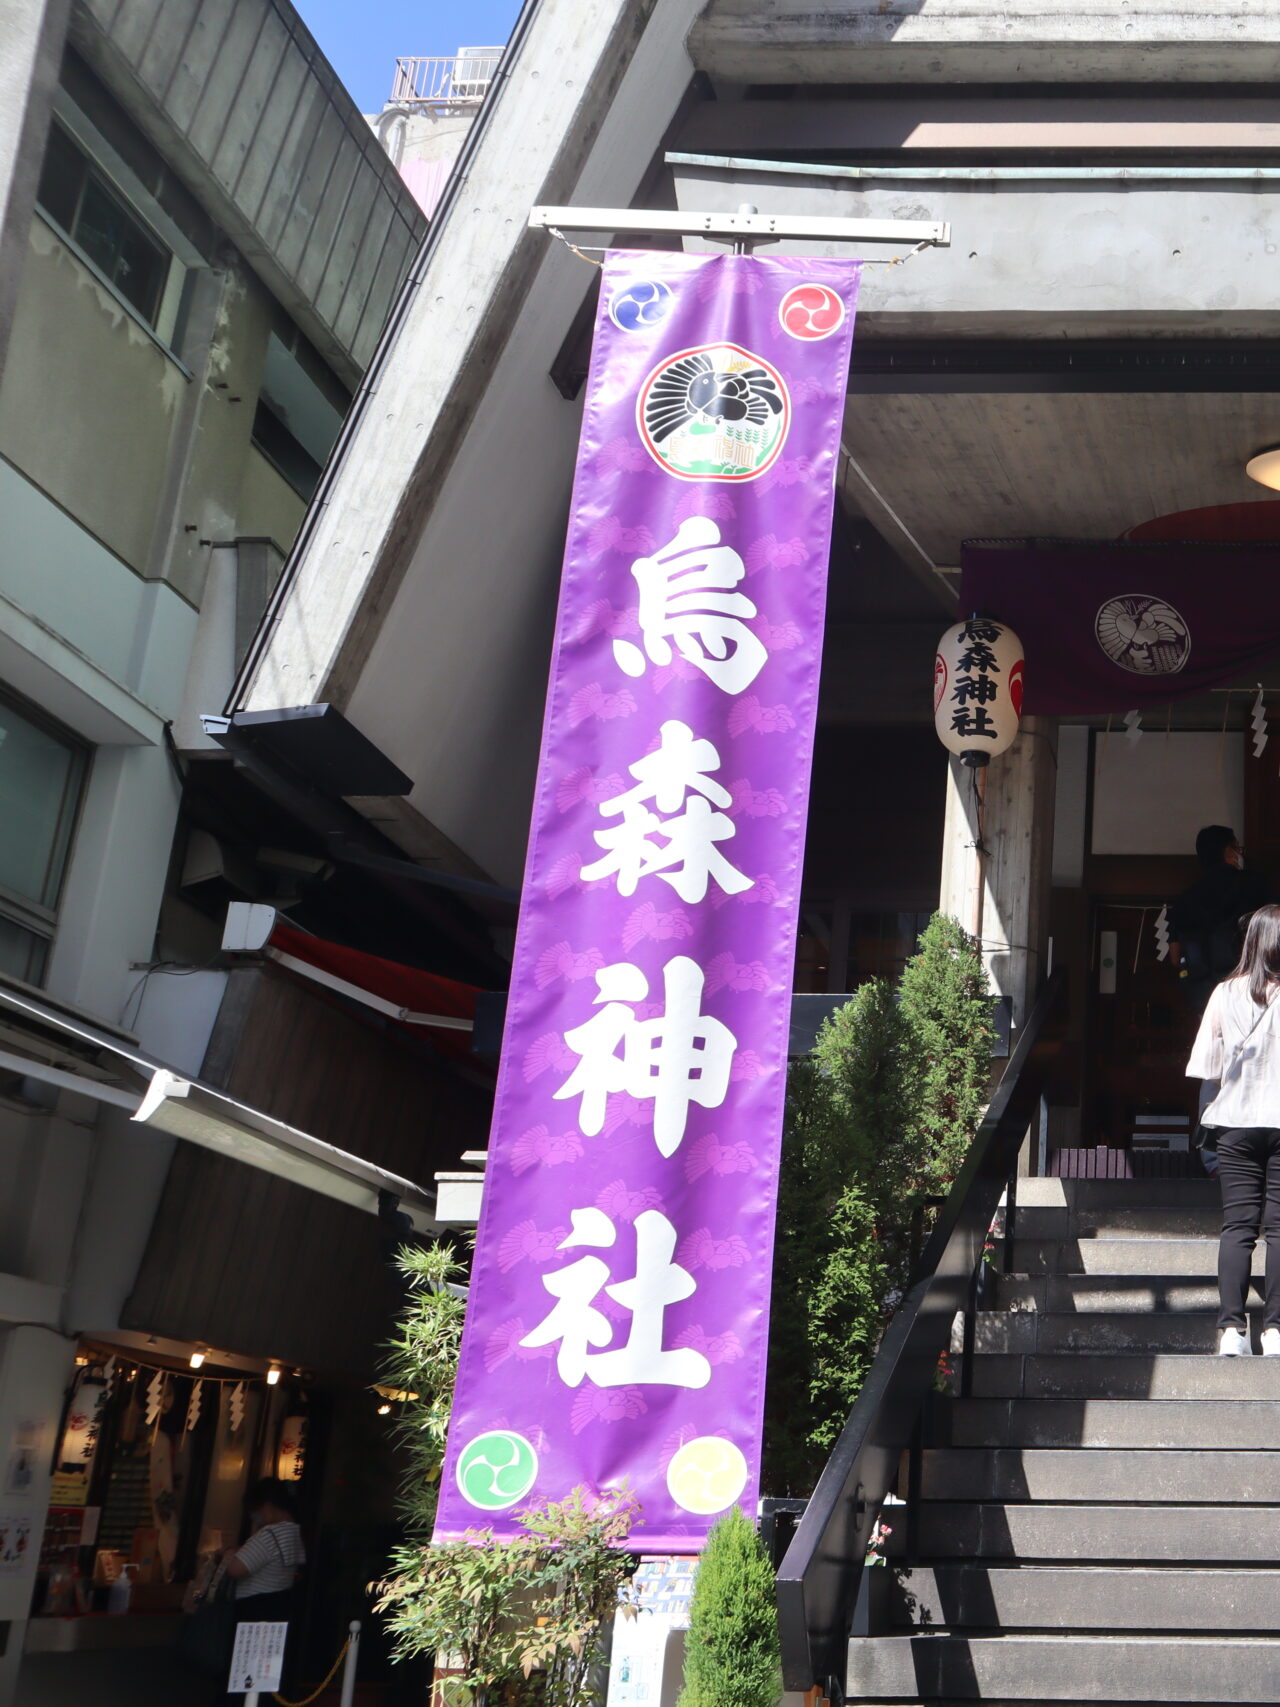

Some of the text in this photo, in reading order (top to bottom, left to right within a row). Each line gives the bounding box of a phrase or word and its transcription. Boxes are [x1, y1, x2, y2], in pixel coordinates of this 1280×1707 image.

[950, 620, 1004, 740] 烏森神社
[518, 516, 769, 1390] 烏森神社
